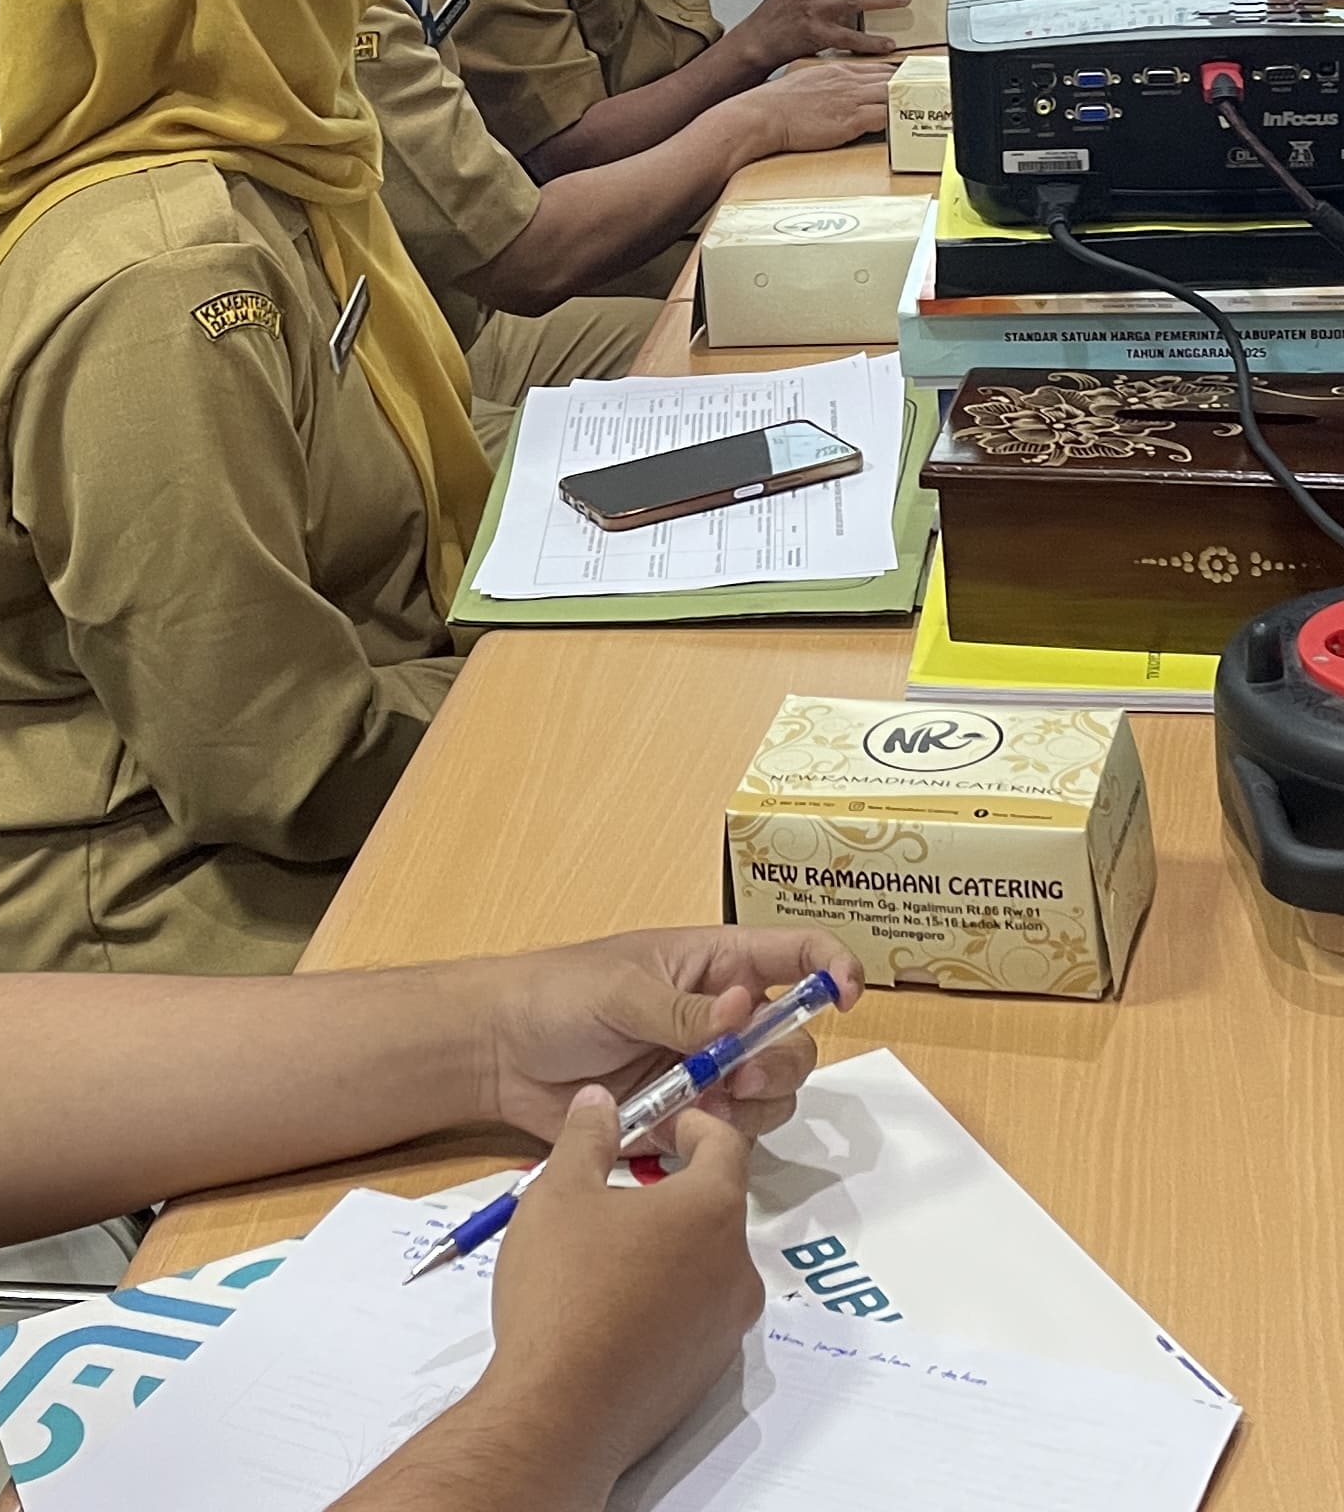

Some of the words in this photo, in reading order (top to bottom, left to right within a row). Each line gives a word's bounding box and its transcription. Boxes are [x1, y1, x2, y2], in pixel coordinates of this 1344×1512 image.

[899, 110, 925, 120] NEW
[1263, 111, 1339, 127] InFocus
[1004, 332, 1057, 342] STANDAR
[1061, 331, 1106, 342] SATUAN
[1111, 331, 1150, 342] HARGA
[1155, 330, 1223, 341] PEMERINTA
[1126, 349, 1164, 359] TAHUN
[1246, 347, 1267, 358] 025
[882, 720, 983, 755] NR
[769, 774, 818, 783] NEW
[821, 774, 952, 789] RAMADHANI
[957, 781, 1062, 796] CATERING
[752, 862, 798, 883] NEW
[806, 867, 941, 895] RAMADHANI
[949, 876, 1064, 901] CATERING
[877, 899, 898, 912] Gg.
[776, 904, 846, 920] Perumahan
[849, 910, 899, 924] Thamrin
[871, 925, 945, 941] Bojonegoro
